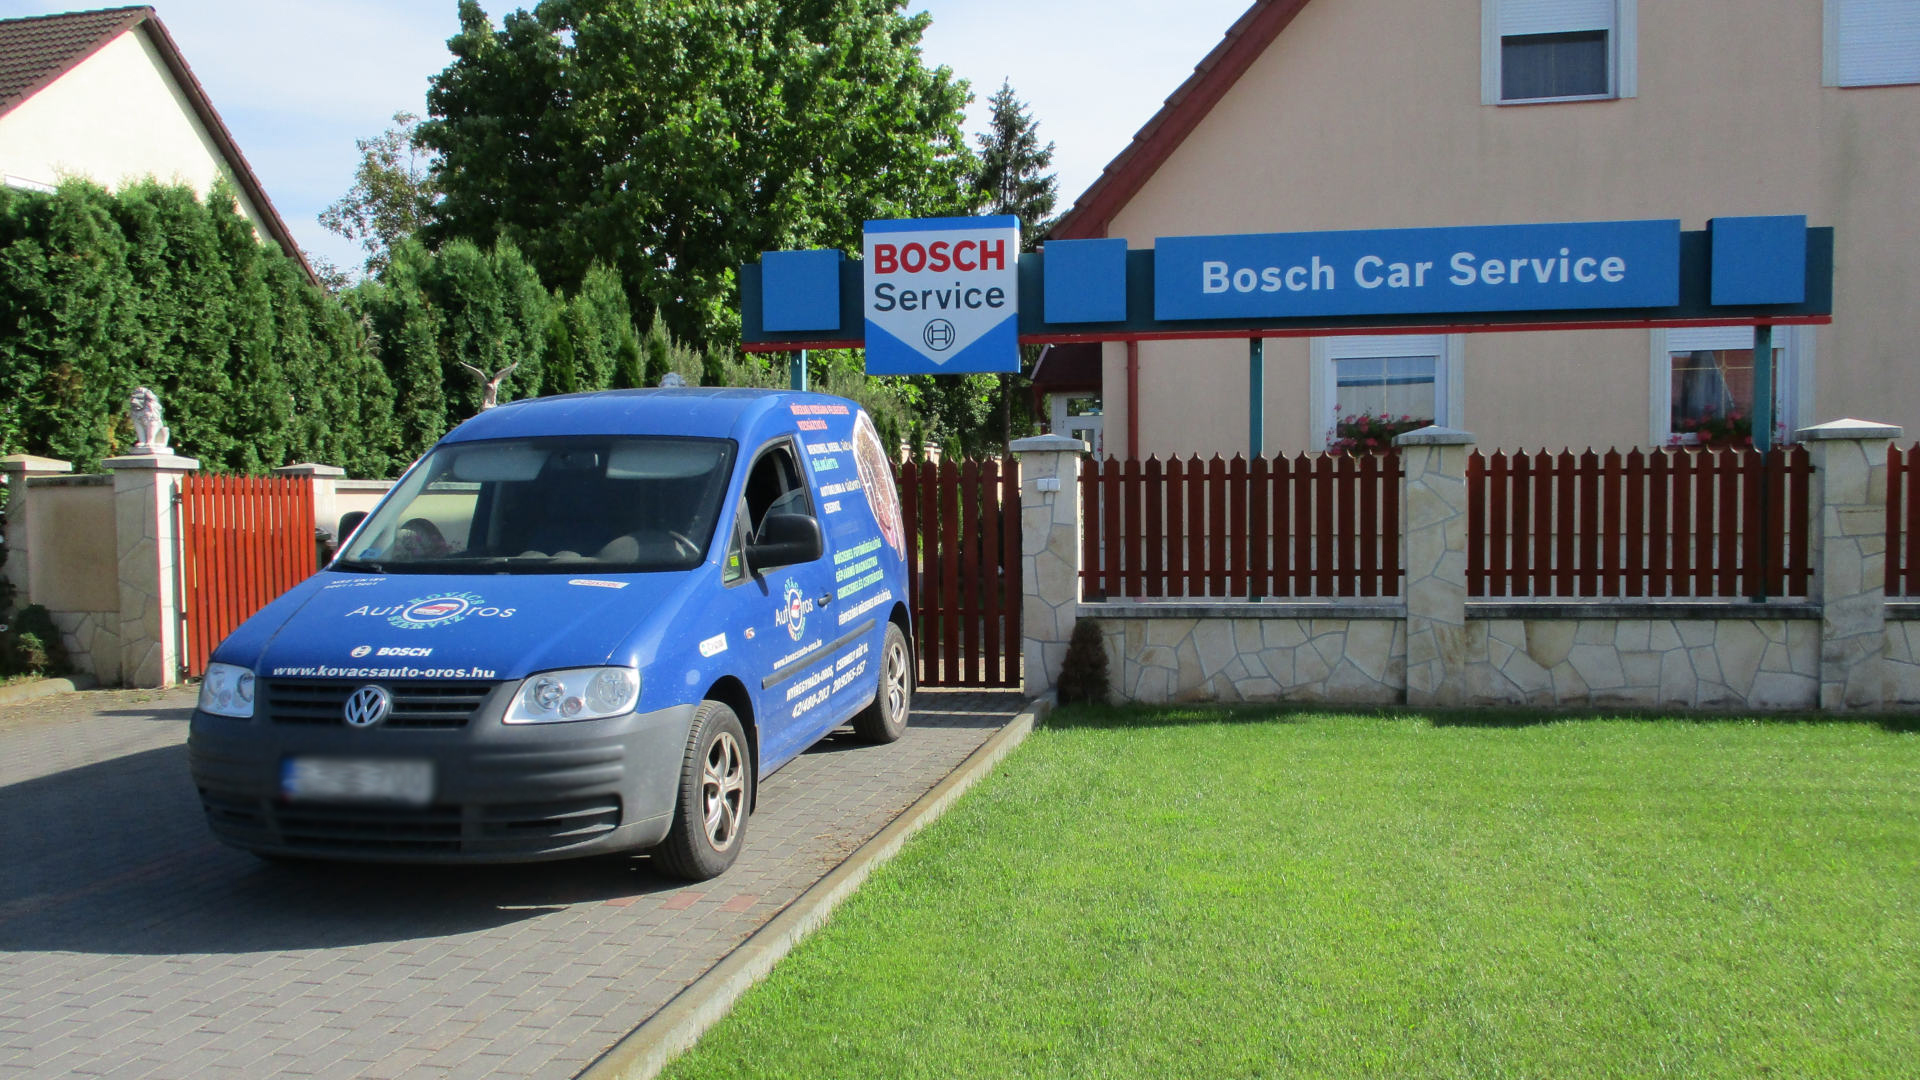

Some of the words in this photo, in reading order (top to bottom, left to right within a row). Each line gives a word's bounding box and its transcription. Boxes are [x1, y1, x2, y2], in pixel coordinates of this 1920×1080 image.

[874, 239, 1005, 274] BOSCH
[1202, 255, 1335, 294] Bosch
[1353, 255, 1433, 289] Car
[1449, 247, 1626, 287] Service
[874, 281, 1005, 312] Service
[376, 647, 433, 657] BOSCH
[273, 665, 496, 678] www.kovacsauto-oros.hu
